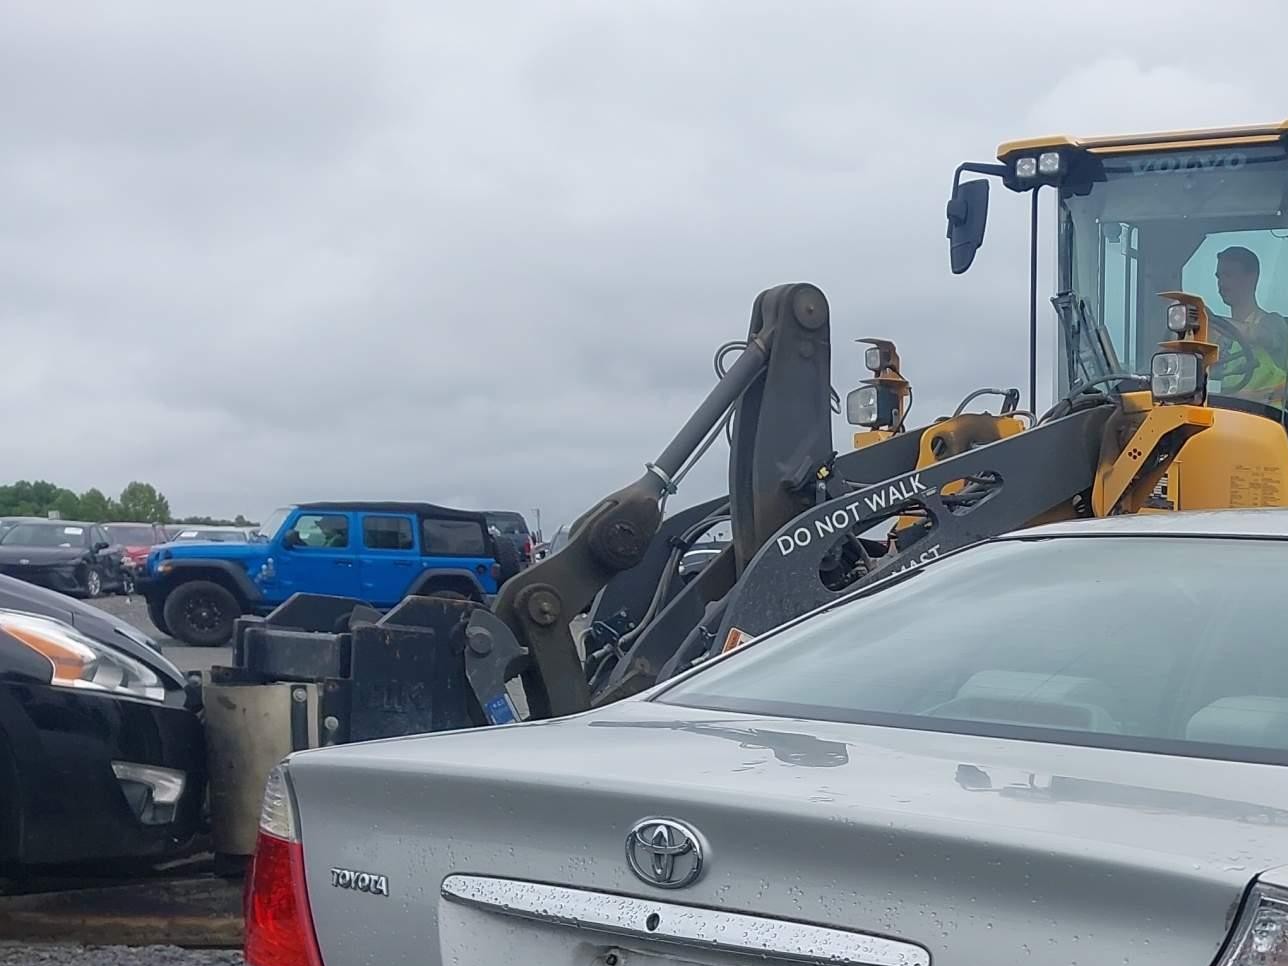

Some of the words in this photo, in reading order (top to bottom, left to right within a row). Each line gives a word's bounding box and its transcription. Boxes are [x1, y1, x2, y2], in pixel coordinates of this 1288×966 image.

[1130, 152, 1247, 176] VOLVO
[777, 528, 812, 556] DO
[816, 502, 860, 537] NOT
[864, 473, 928, 513] WALK
[330, 867, 389, 897] TOYOTA
